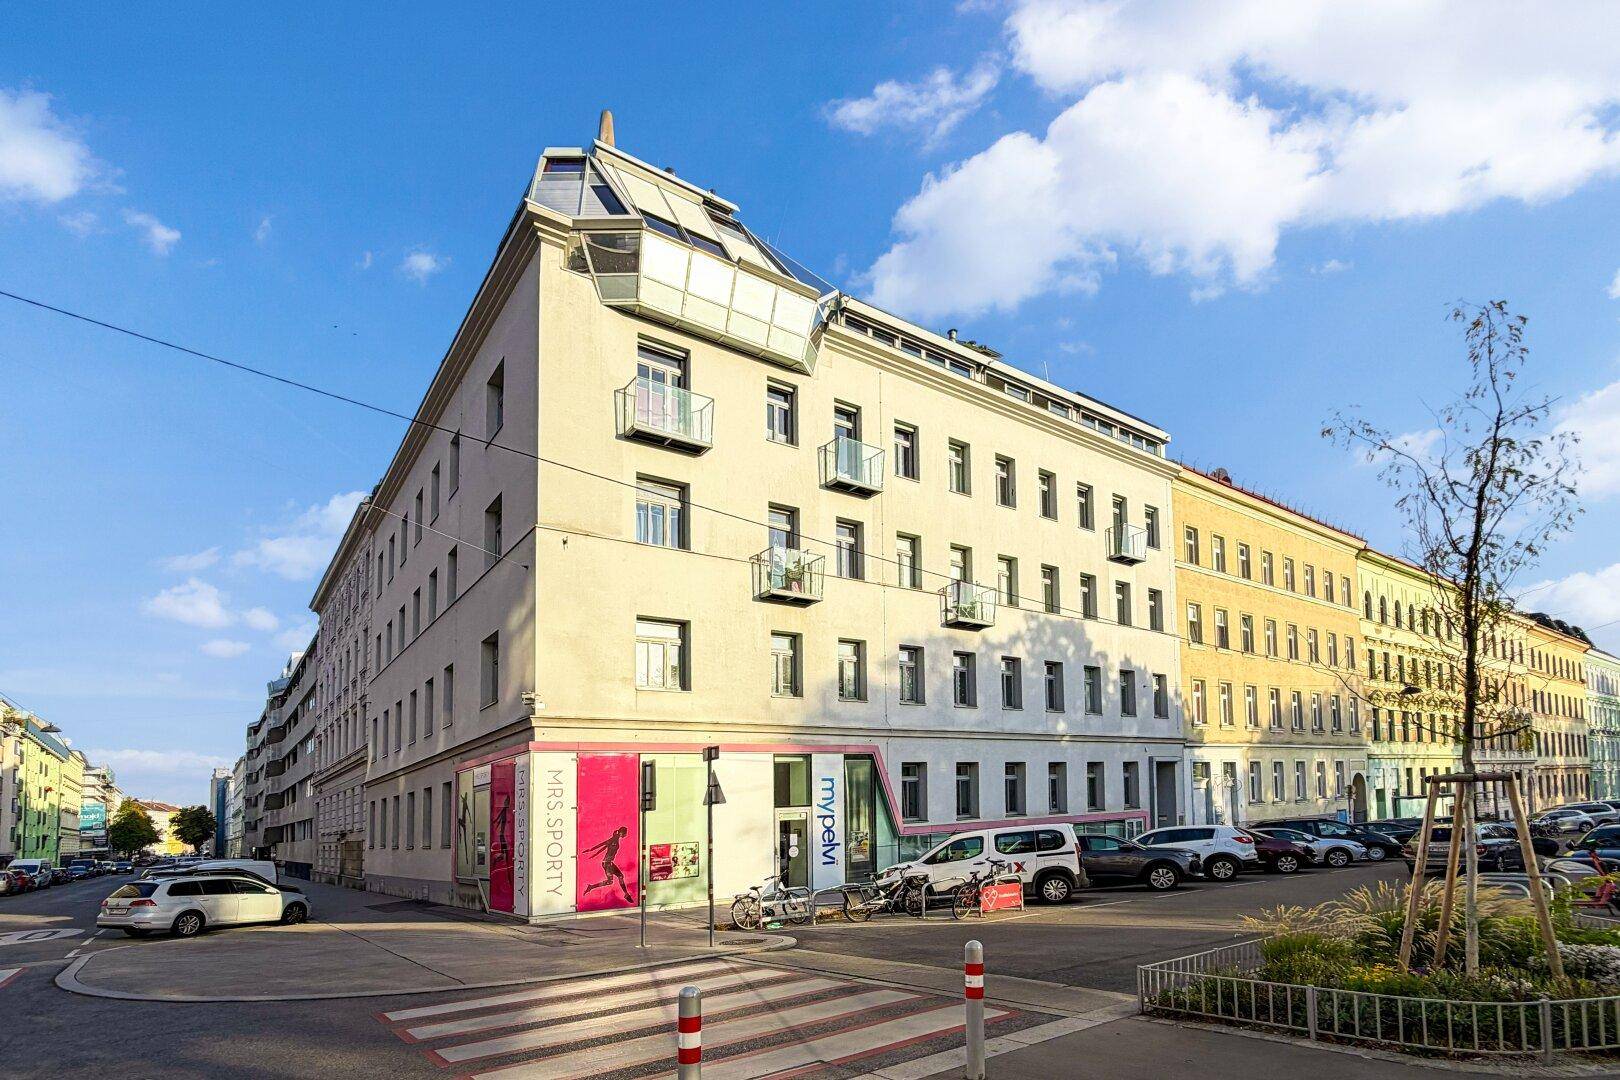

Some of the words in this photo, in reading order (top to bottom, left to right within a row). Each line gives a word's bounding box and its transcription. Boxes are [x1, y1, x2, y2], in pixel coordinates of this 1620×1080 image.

[517, 769, 525, 896] MRS.SPORTY
[546, 769, 563, 896] MRS.SPORTY
[816, 777, 841, 866] mypelvi
